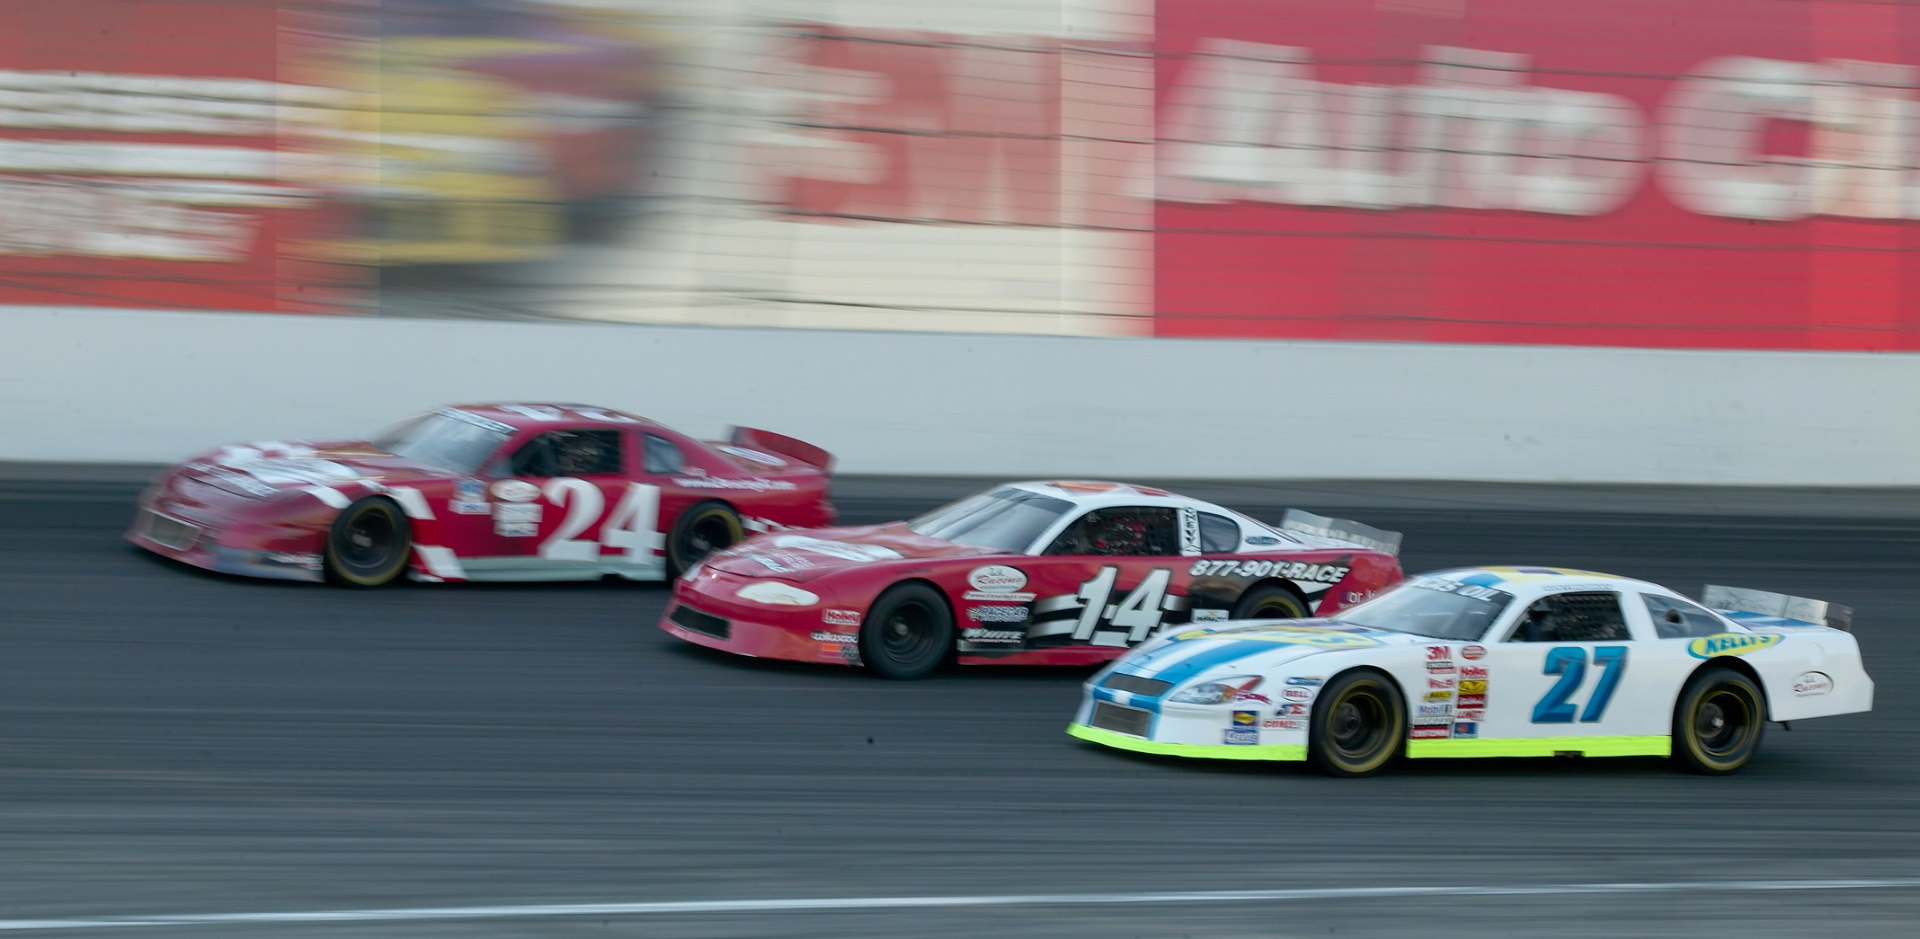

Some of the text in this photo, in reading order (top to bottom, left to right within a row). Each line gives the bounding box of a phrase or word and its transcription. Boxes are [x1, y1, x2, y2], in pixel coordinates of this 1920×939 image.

[537, 477, 667, 565] 24
[1071, 566, 1172, 643] 14
[1456, 584, 1500, 602] OIL
[1427, 645, 1452, 660] 3M
[1531, 646, 1630, 724] 27
